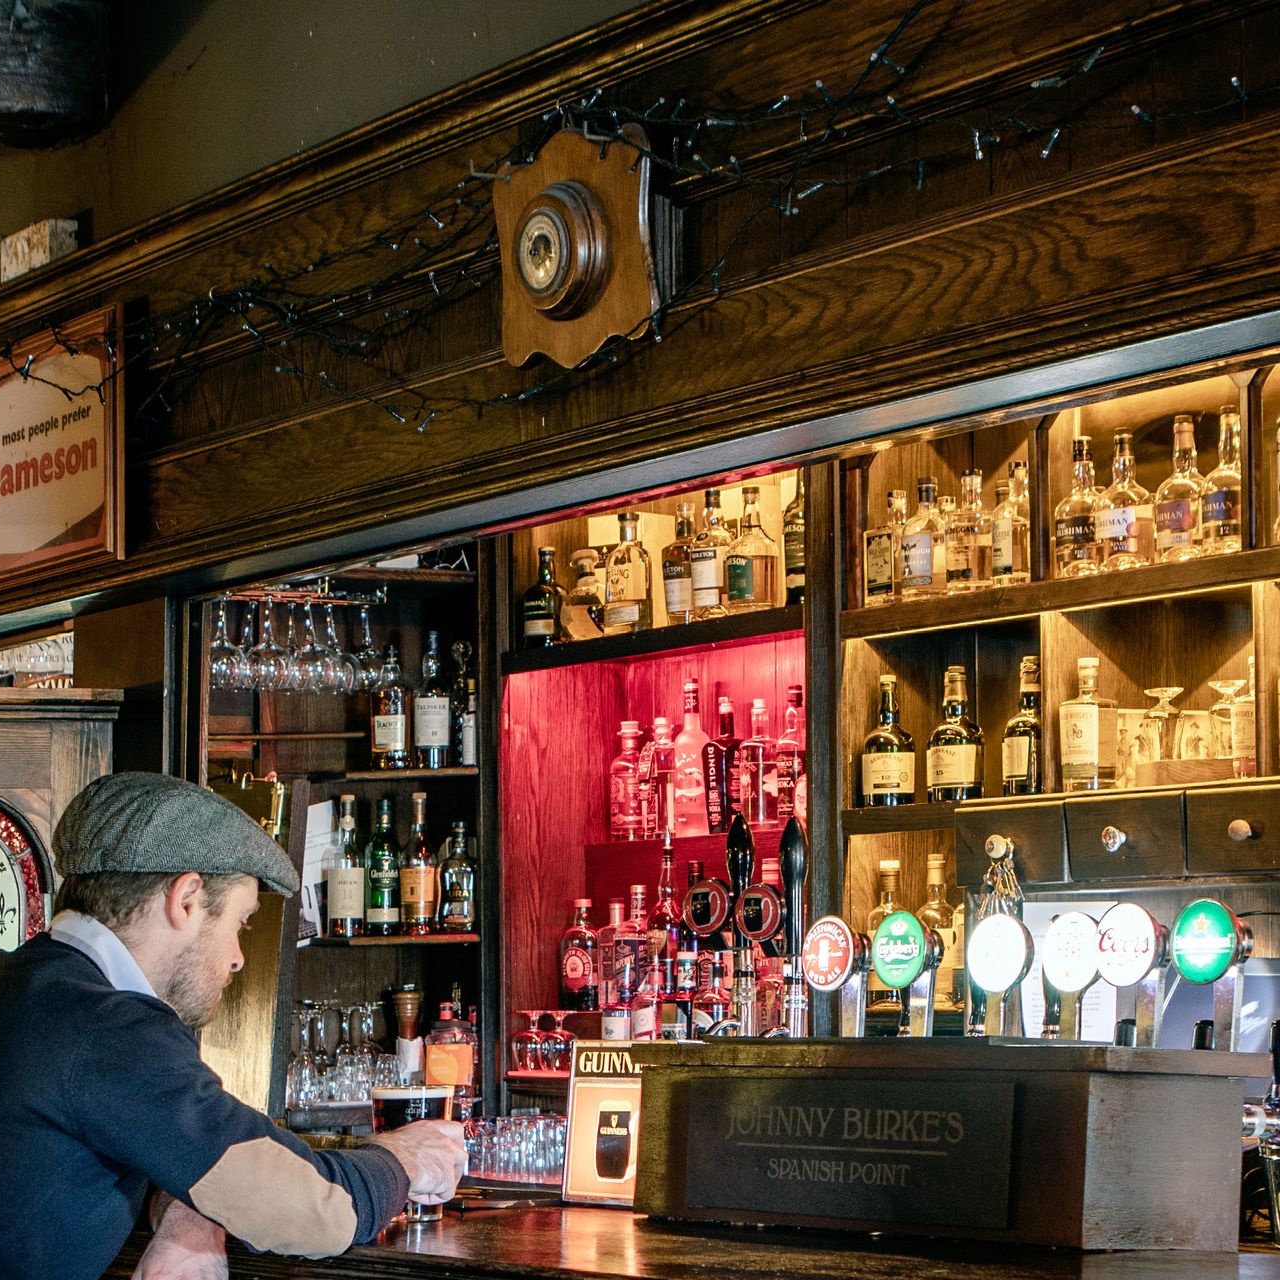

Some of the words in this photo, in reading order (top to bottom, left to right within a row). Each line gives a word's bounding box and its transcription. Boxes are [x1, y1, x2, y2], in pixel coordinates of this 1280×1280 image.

[2, 426, 26, 446] most
[28, 416, 59, 442] people
[61, 404, 91, 431] prefer
[945, 526, 976, 534] BEGGAN
[1220, 525, 1230, 535] 12
[707, 746, 717, 788] DINGLE
[876, 936, 920, 959] Carlsberg
[808, 971, 826, 984] RED
[827, 966, 841, 983] ALE
[579, 1051, 643, 1074] GUINN
[599, 1127, 628, 1136] GUINNESS
[724, 1103, 836, 1141] JOHNNY
[841, 1106, 966, 1145] BURKE'S
[767, 1157, 844, 1184] SPANISH
[848, 1161, 912, 1187] POINT
